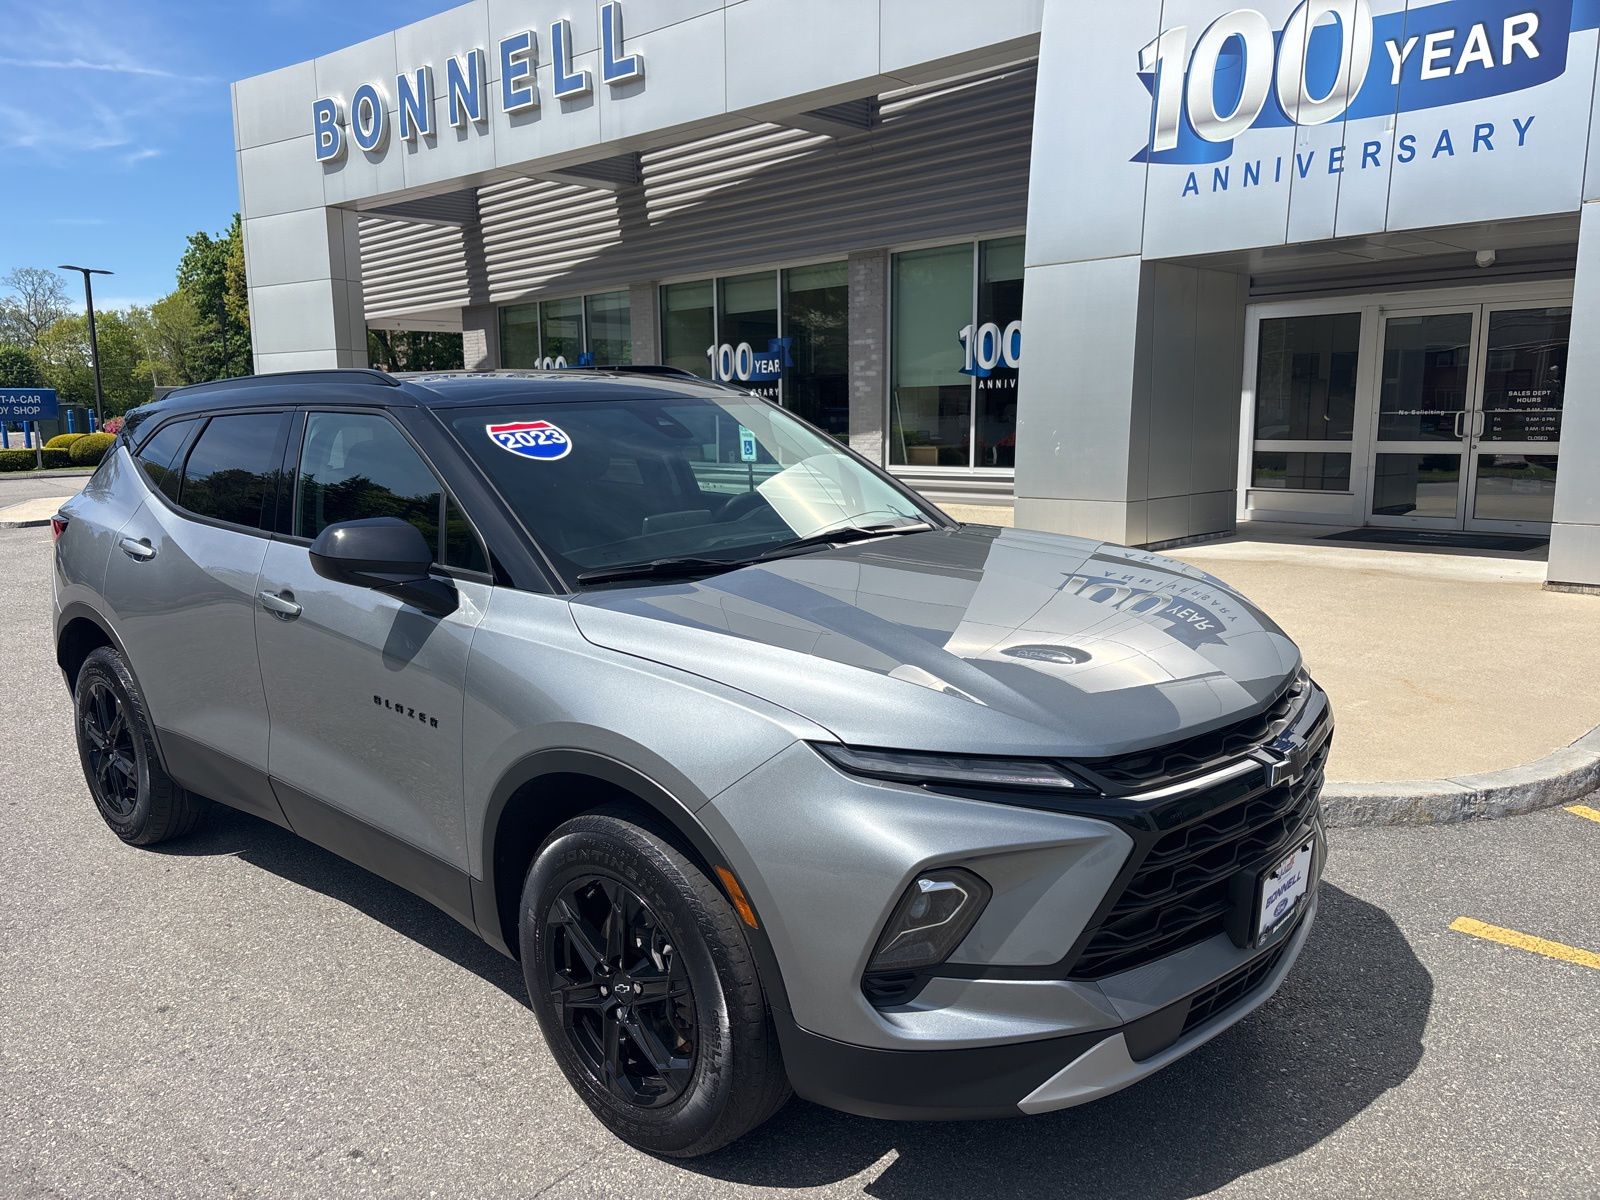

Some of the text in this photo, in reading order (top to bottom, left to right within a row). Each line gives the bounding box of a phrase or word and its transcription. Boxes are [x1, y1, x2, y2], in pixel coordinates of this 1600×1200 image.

[312, 1, 644, 163] BONNELL
[1138, 0, 1541, 153] 100 YEAR
[1182, 116, 1535, 197] ANNIVERSARY
[707, 342, 781, 382] 100 YEAR
[958, 320, 1022, 371] 100
[13, 406, 41, 415] SHOP
[499, 429, 567, 450] 2023
[373, 694, 438, 729] BLAZER
[1265, 870, 1302, 910] BONNELL
